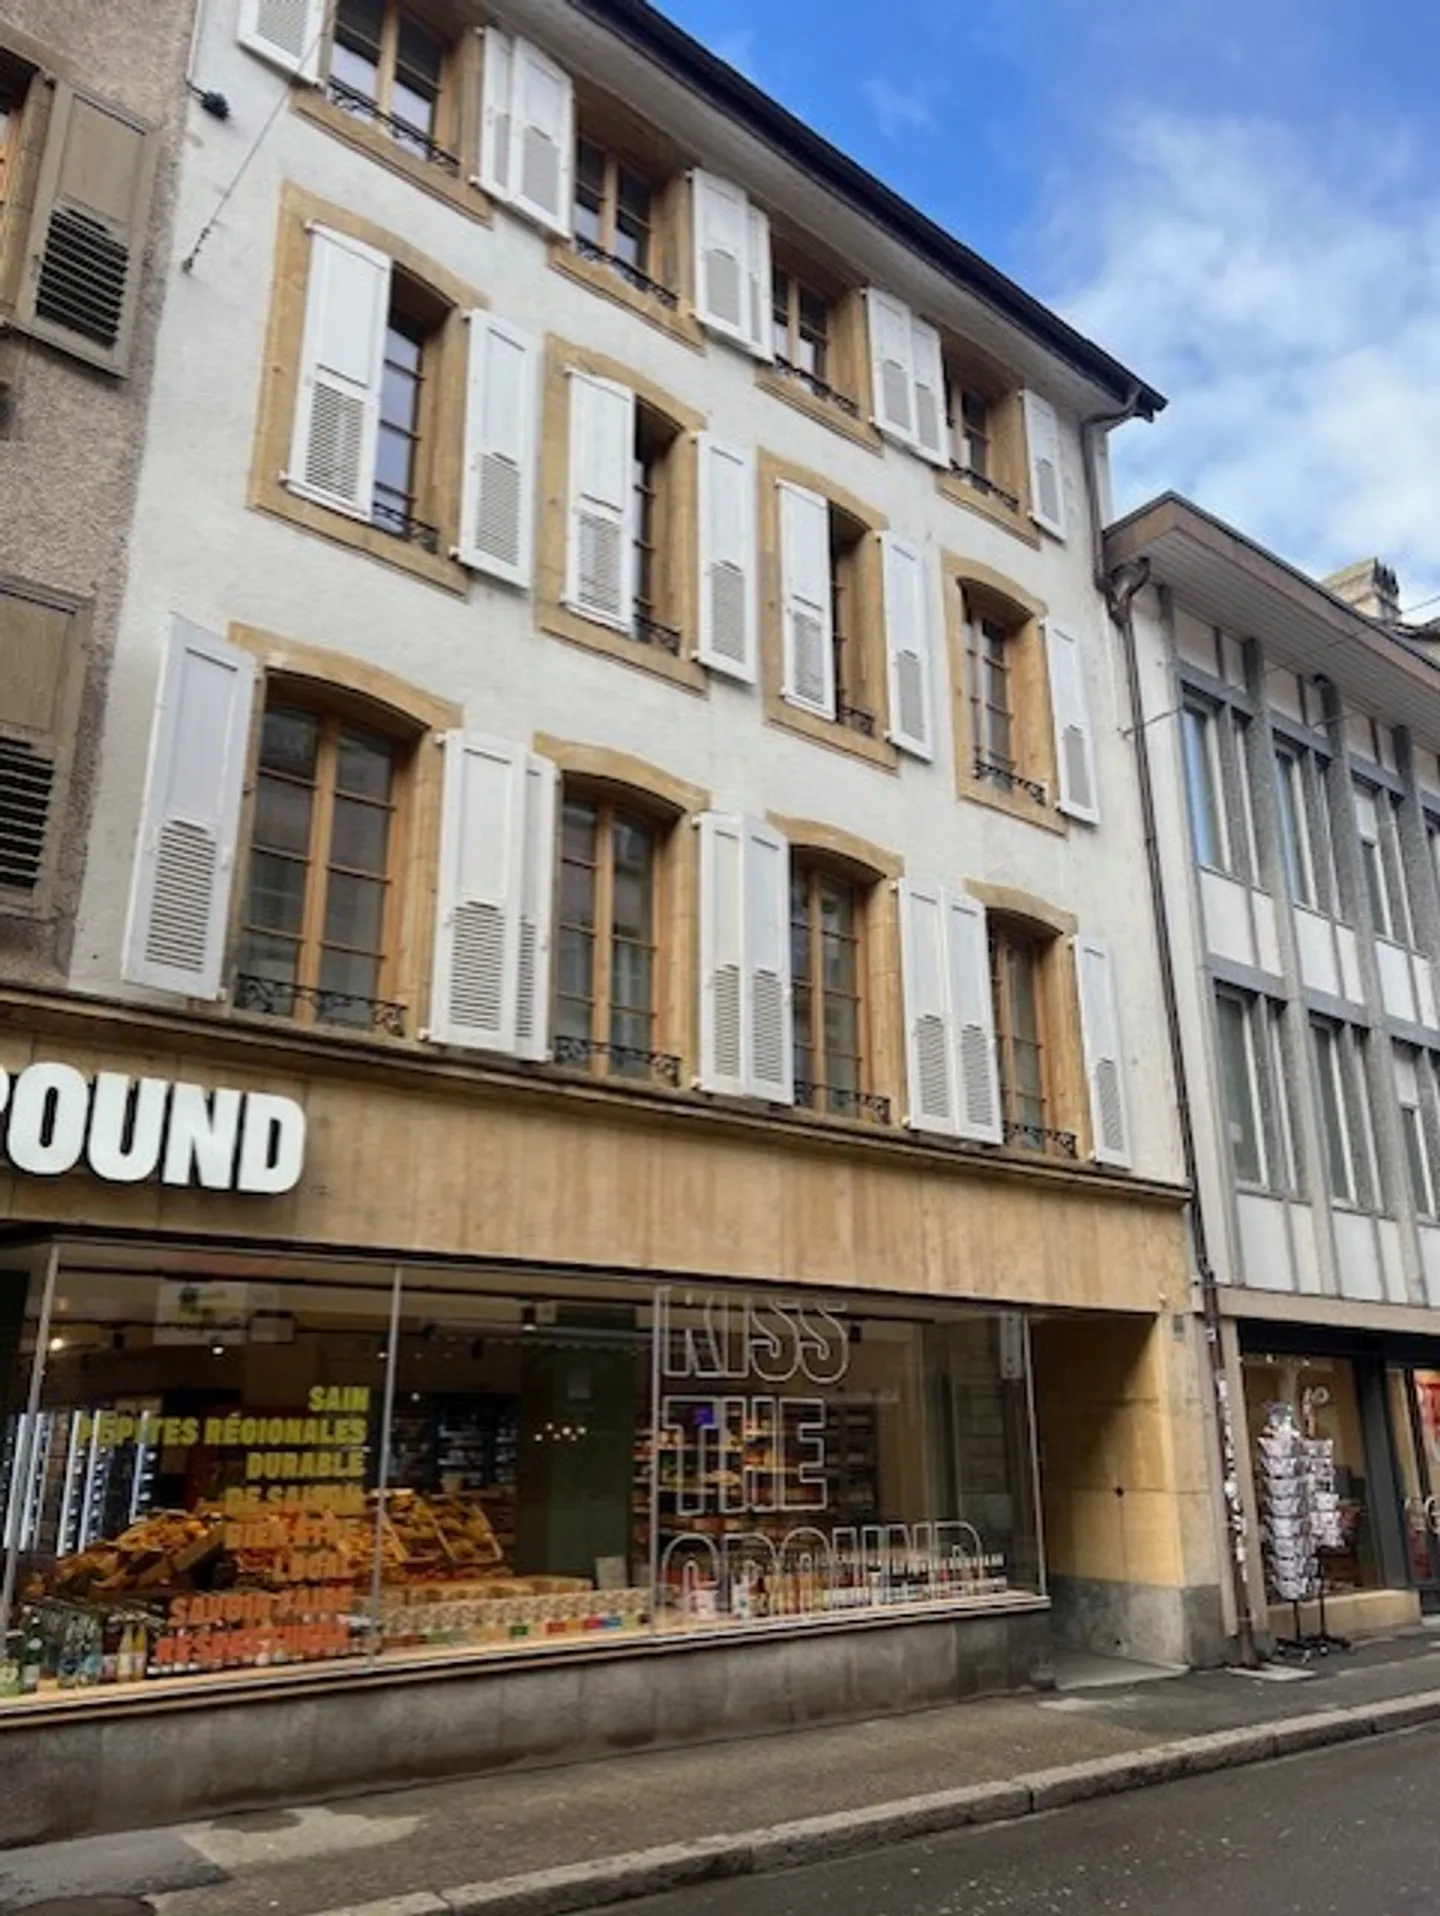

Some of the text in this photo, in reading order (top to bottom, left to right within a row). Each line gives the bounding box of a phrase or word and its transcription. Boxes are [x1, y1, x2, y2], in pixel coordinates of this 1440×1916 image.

[0, 1062, 306, 1193] OUND
[663, 1286, 849, 1384] KISS
[203, 1410, 367, 1446] RÉGIONALES
[308, 1385, 371, 1412] SAIN
[245, 1451, 365, 1479] DURABLE
[662, 1395, 828, 1516] THE
